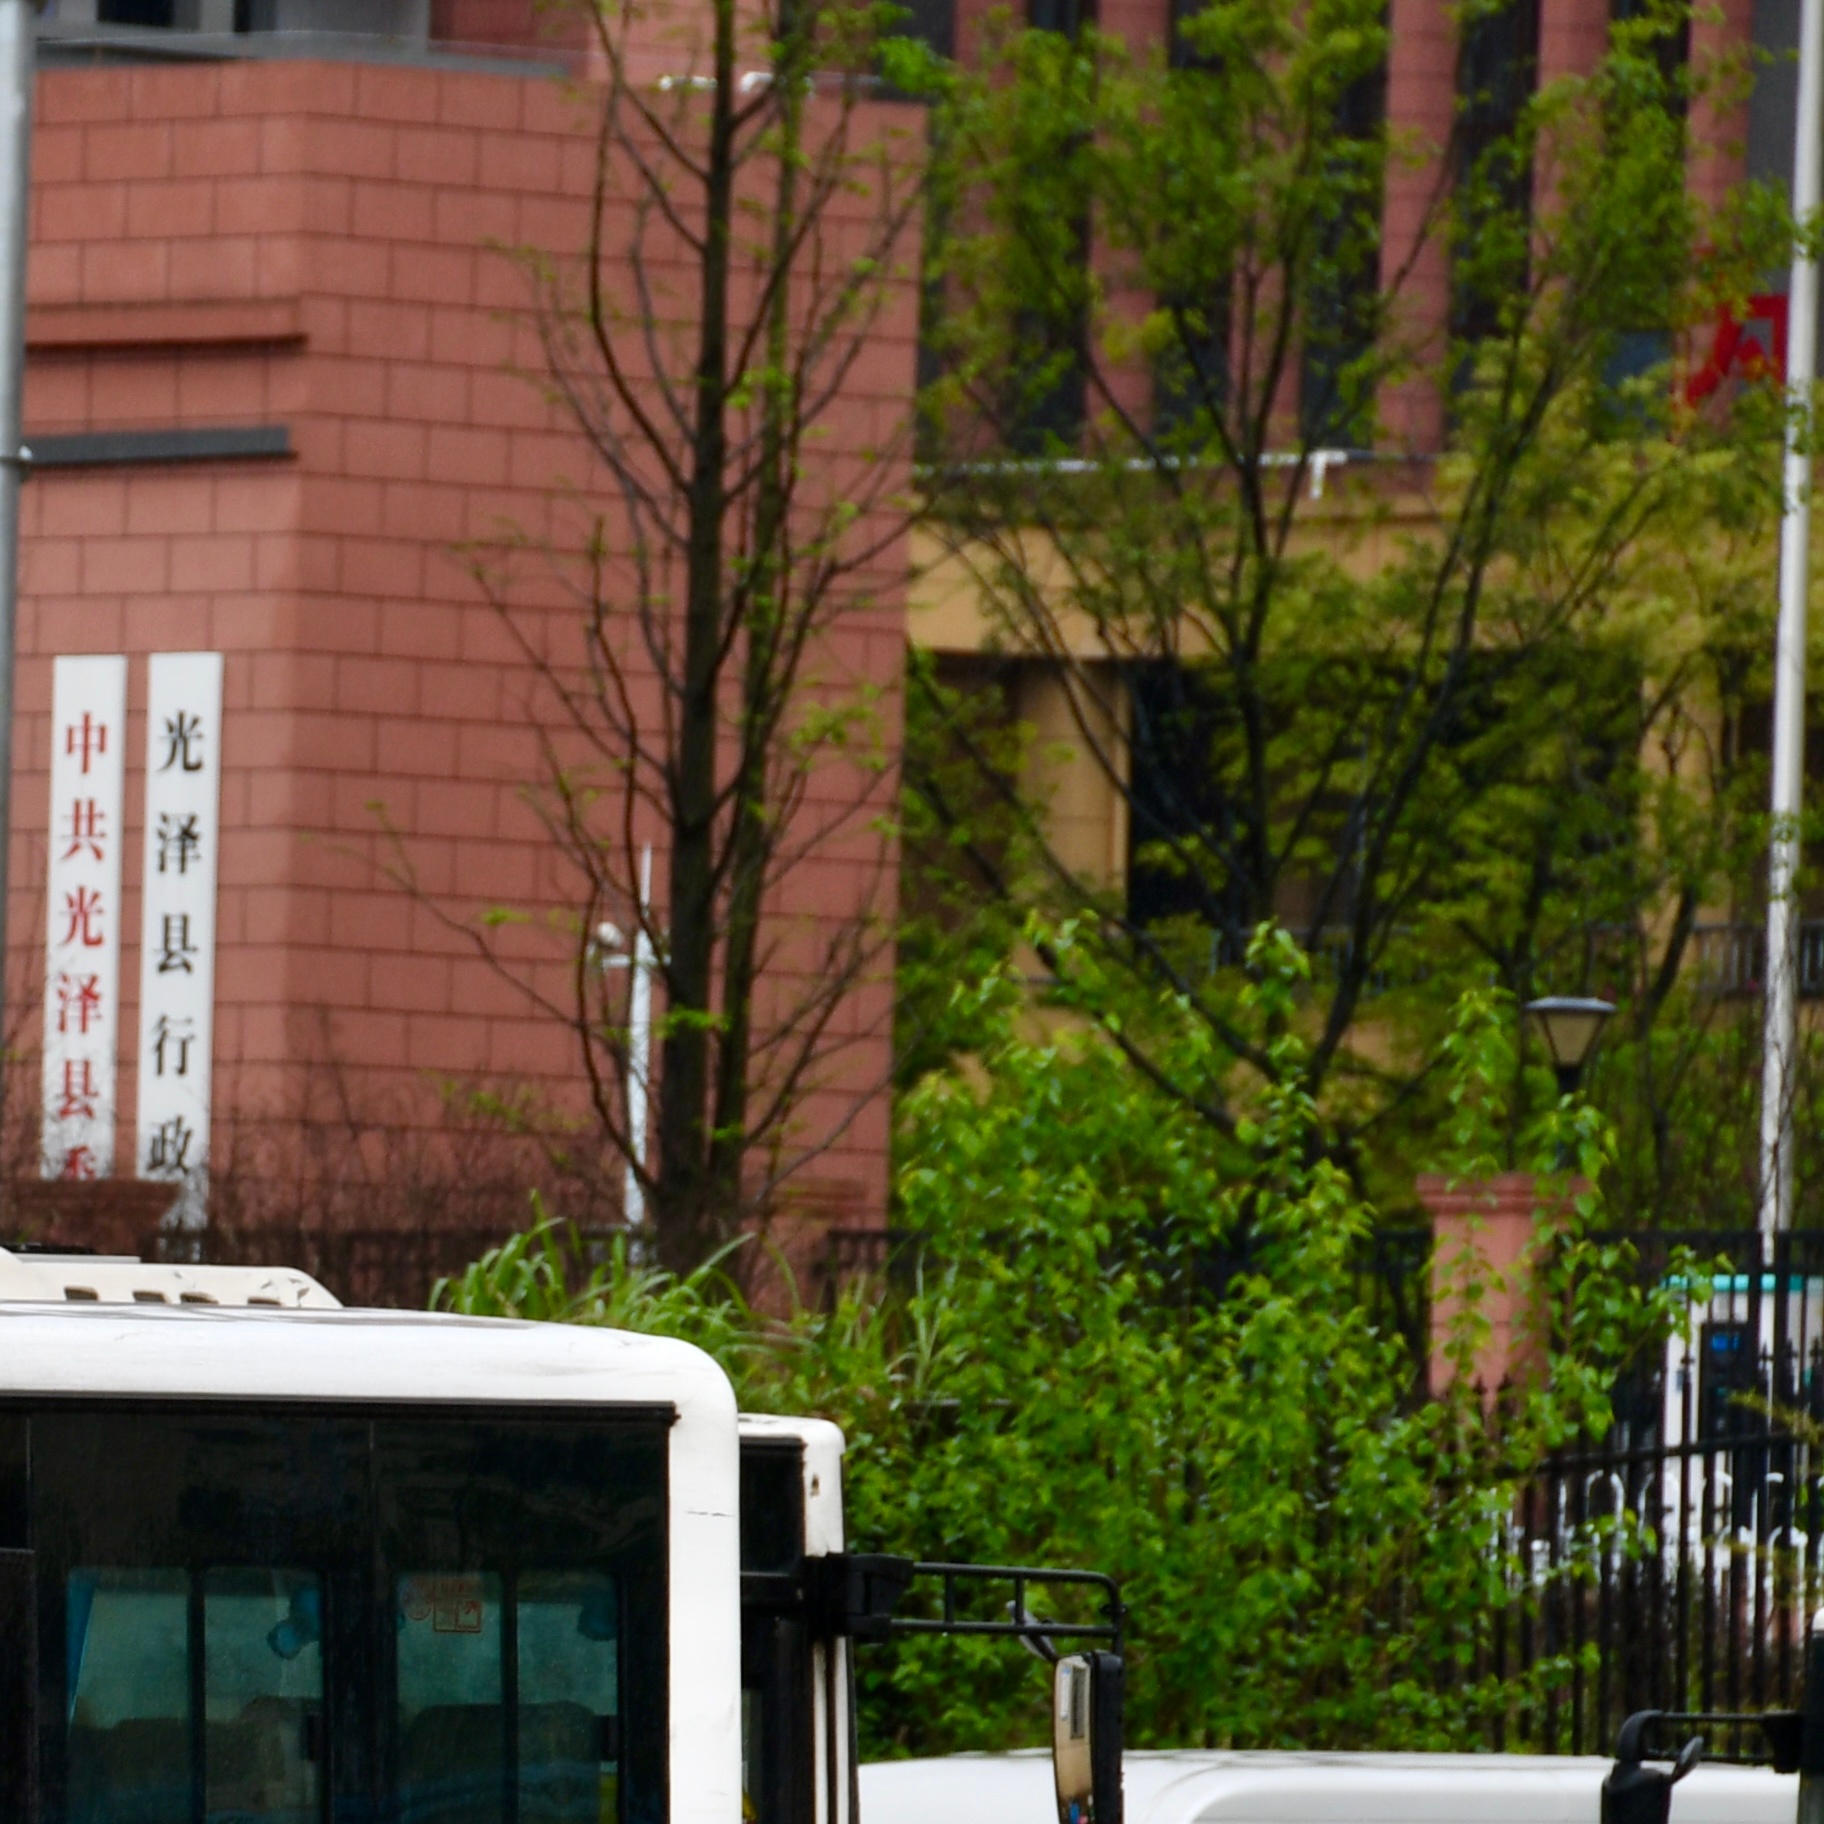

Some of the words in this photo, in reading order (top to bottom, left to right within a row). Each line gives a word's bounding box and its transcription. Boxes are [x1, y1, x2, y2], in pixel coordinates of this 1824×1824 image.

[147, 709, 205, 1178] 光泽县行政
